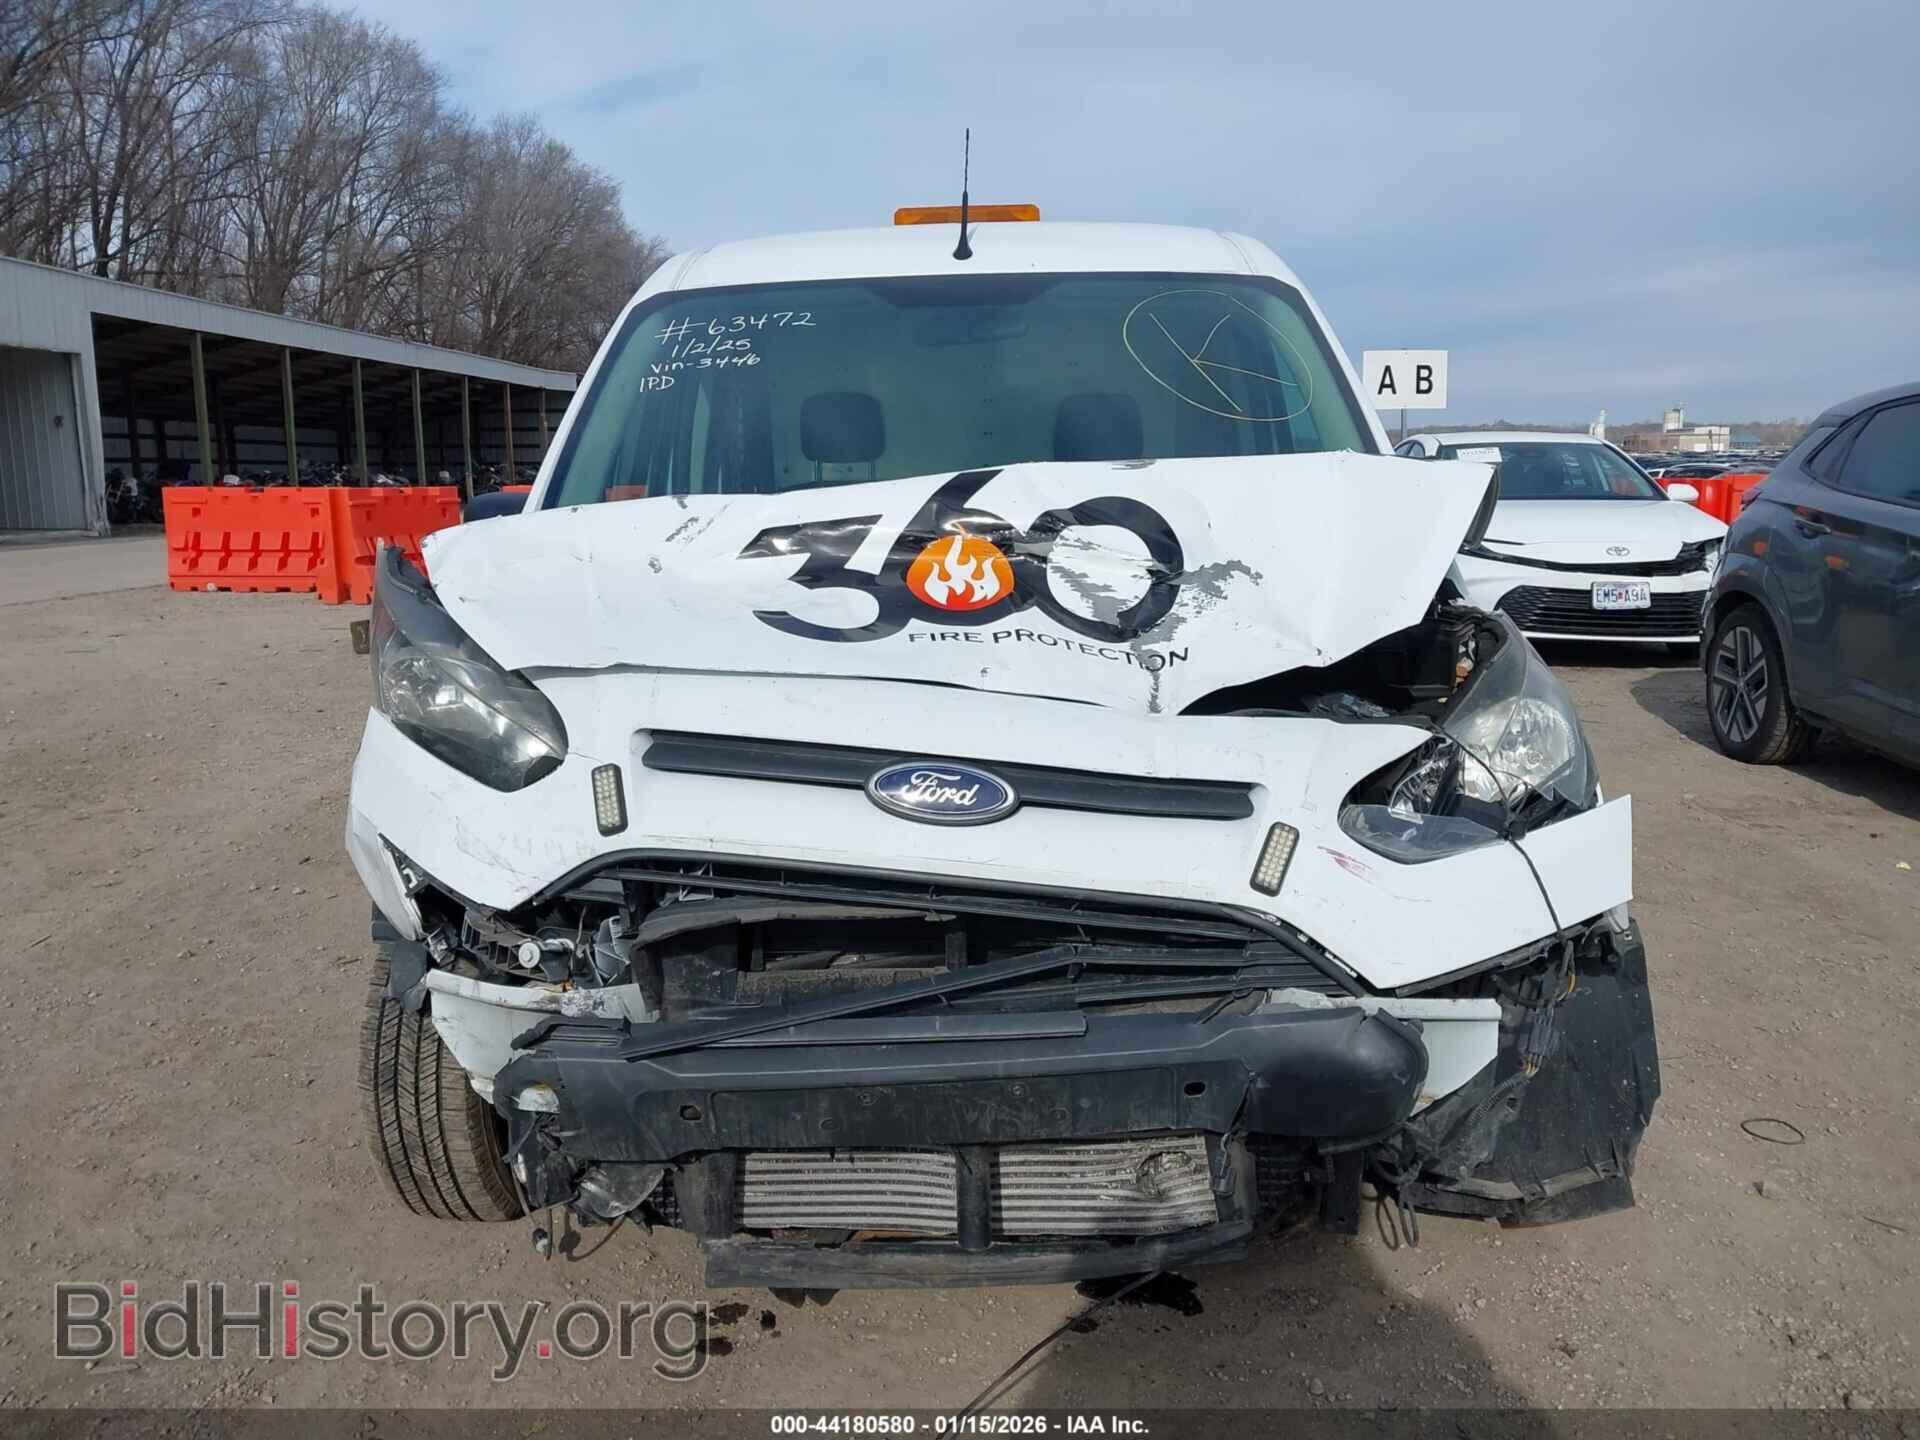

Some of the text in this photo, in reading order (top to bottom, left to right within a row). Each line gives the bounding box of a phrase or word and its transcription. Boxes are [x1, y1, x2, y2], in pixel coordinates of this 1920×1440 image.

[671, 335, 751, 358] 1/2/25
[1377, 365, 1433, 395] A B
[736, 469, 1185, 644] 360
[908, 631, 984, 643] FIRE
[900, 770, 980, 806] Ford
